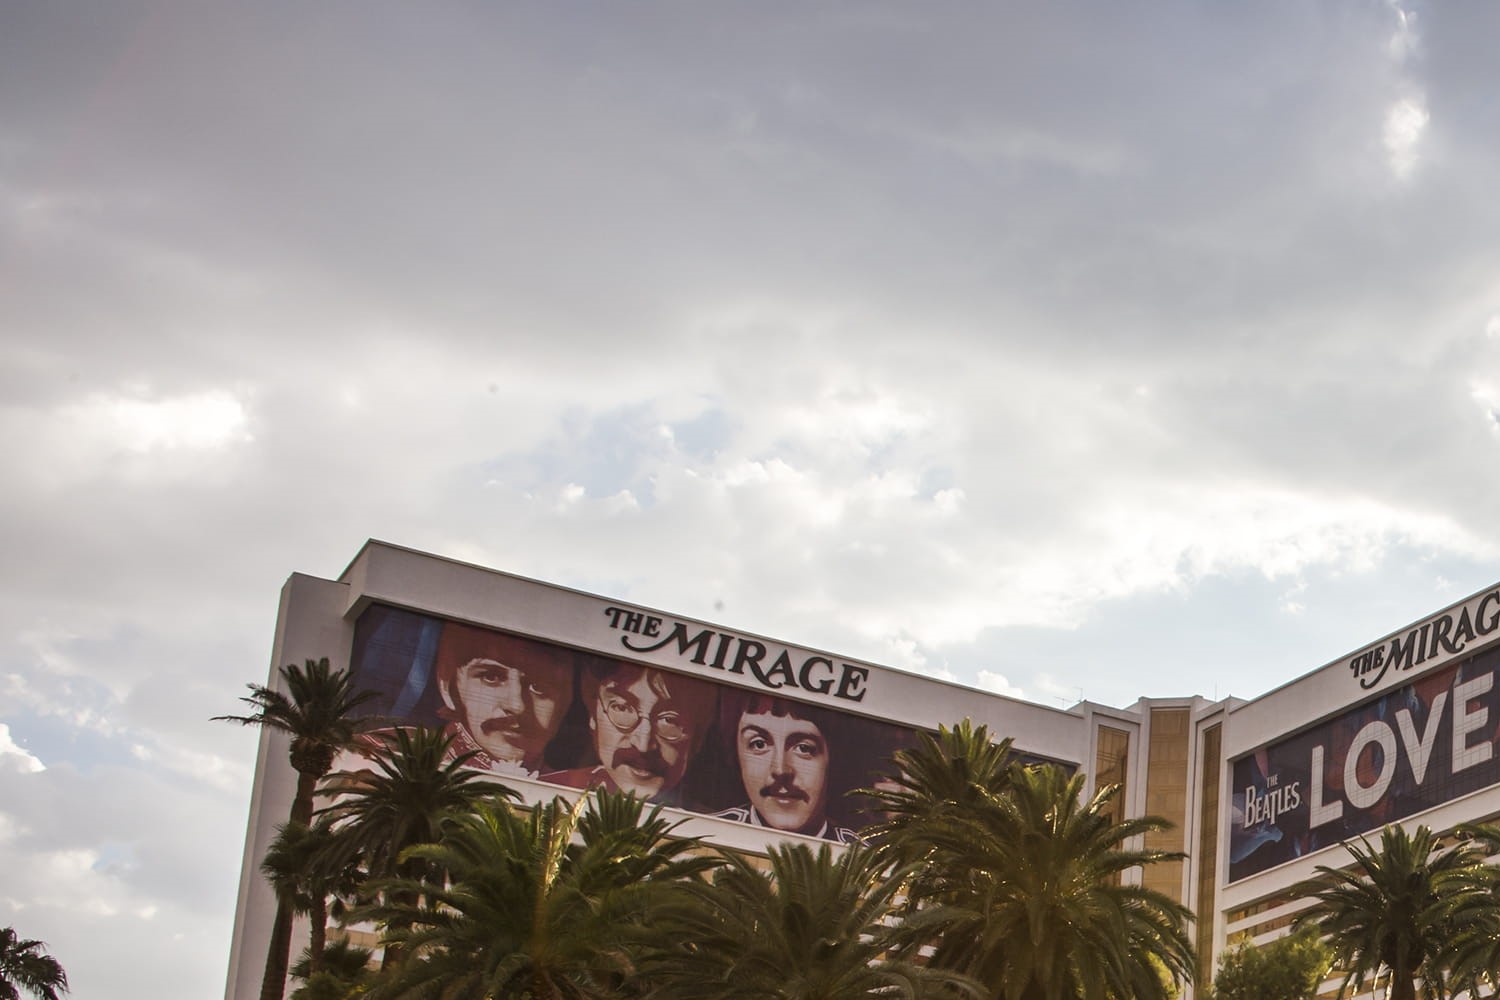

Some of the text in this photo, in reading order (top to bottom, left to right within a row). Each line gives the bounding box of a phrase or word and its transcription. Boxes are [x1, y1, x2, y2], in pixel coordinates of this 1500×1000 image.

[604, 606, 870, 702] THE MIRAGE
[1350, 645, 1385, 678] THE
[1309, 671, 1494, 830] LOVE
[1267, 774, 1279, 789] THE
[1244, 782, 1301, 829] BEATLES
